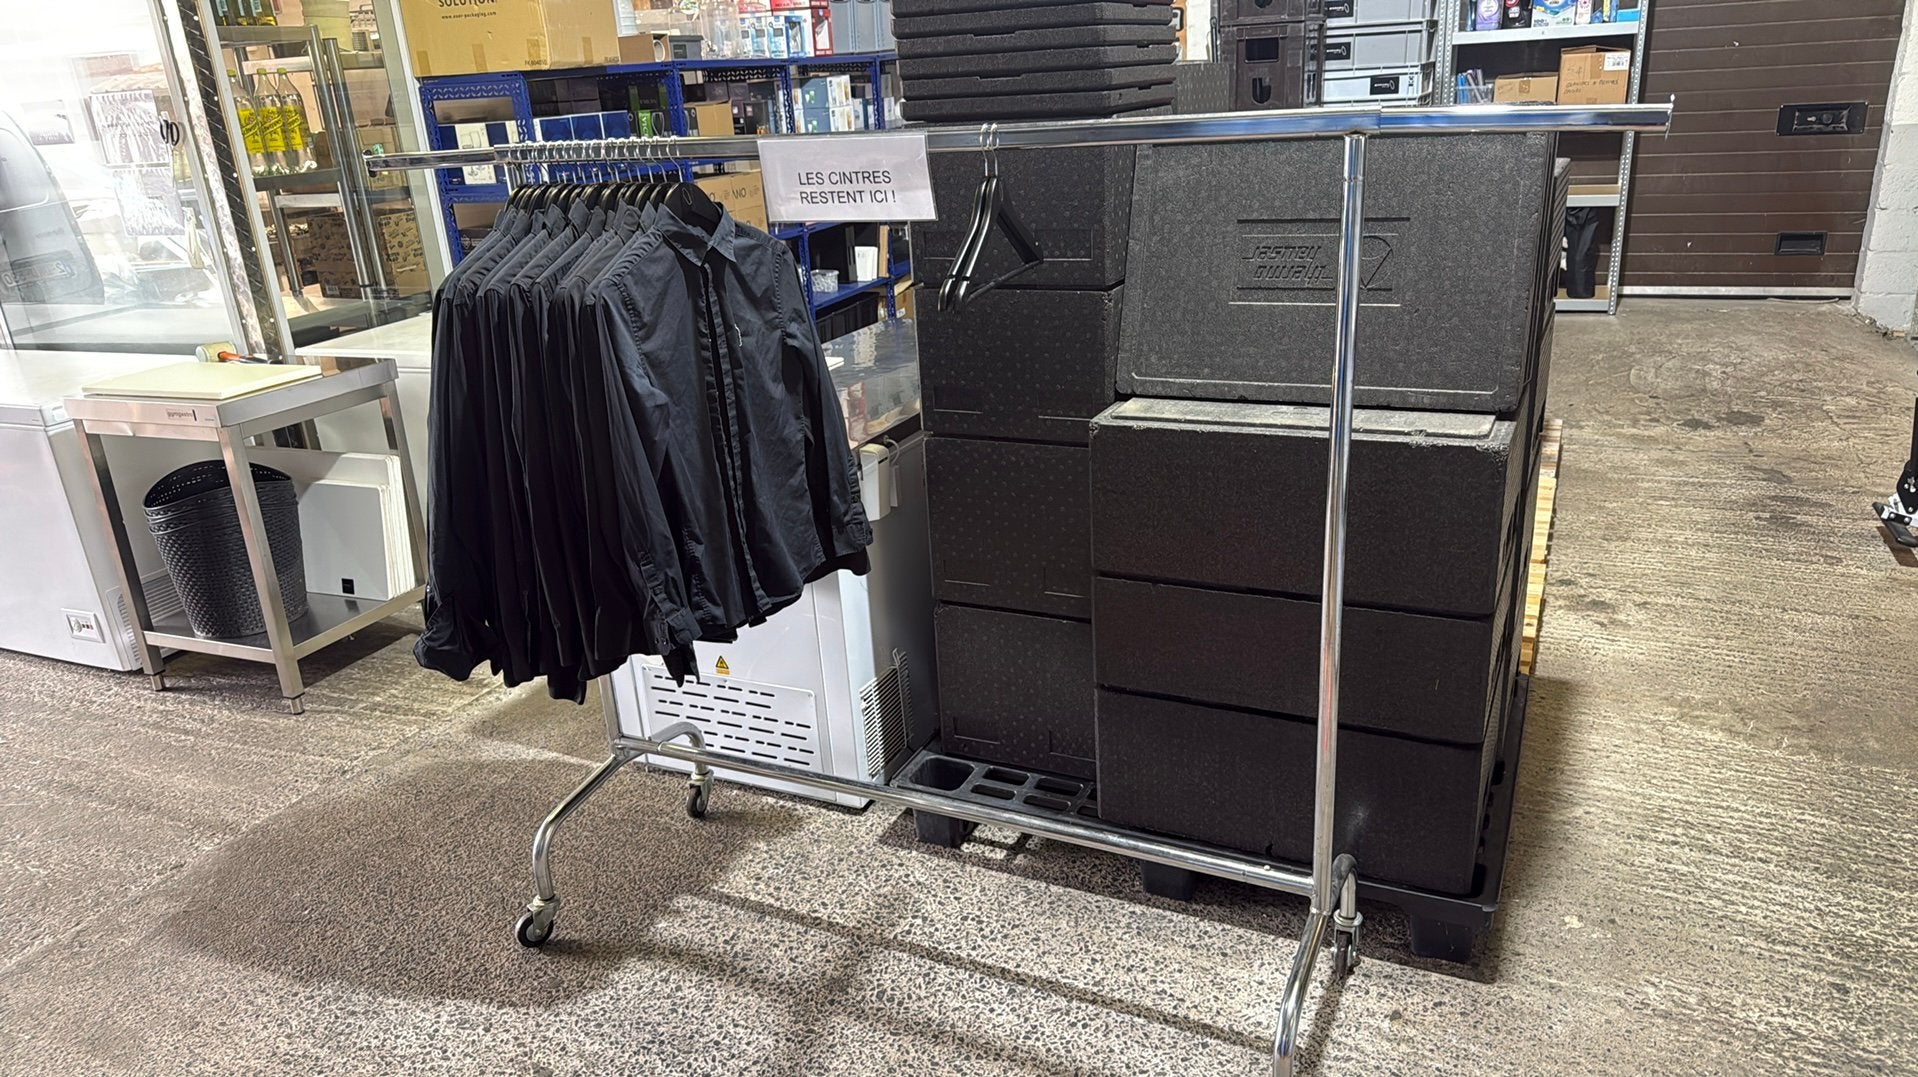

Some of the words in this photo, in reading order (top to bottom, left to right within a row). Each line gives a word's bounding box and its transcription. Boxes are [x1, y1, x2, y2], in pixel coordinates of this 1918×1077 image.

[798, 171, 825, 186] LES
[828, 170, 892, 185] CINTRES
[800, 190, 865, 204] RESTENT
[869, 189, 888, 203] ICI
[892, 189, 896, 203] !
